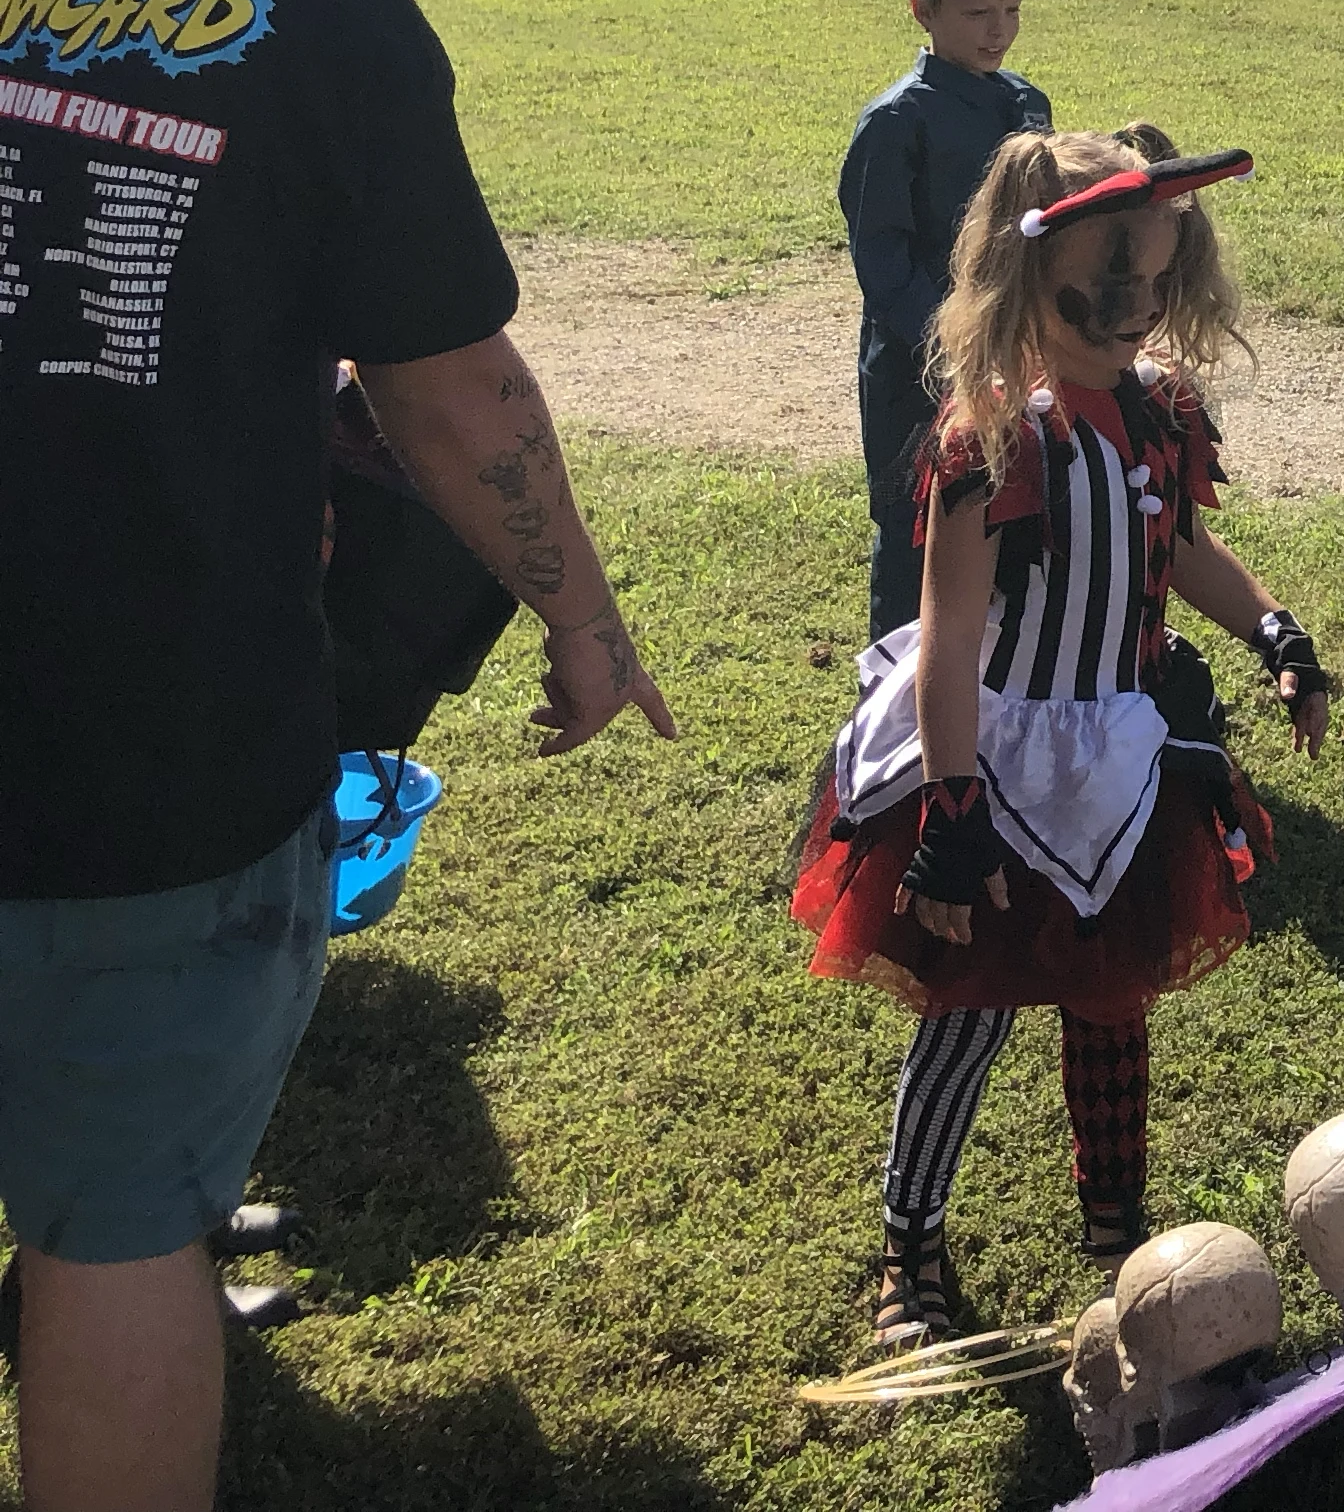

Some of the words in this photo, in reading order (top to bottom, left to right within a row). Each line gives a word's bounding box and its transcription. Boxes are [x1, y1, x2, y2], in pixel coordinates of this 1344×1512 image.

[62, 94, 129, 139] FUN
[128, 111, 222, 160] TOUR
[87, 161, 128, 179] GRAND
[129, 167, 178, 187] RAPIDS,
[182, 177, 199, 191] MI
[94, 182, 173, 204] PITTSBURGH,
[176, 195, 193, 207] PA
[101, 203, 167, 221] LEXINGTON,
[170, 210, 189, 223] KY
[85, 217, 160, 238] MANCHESTER,
[160, 244, 178, 257] CT
[44, 248, 85, 264] NORTH
[155, 262, 172, 274] SC
[106, 332, 145, 349] TULSA,
[40, 361, 91, 373] CORPUS
[101, 348, 144, 367] AUSTIN,
